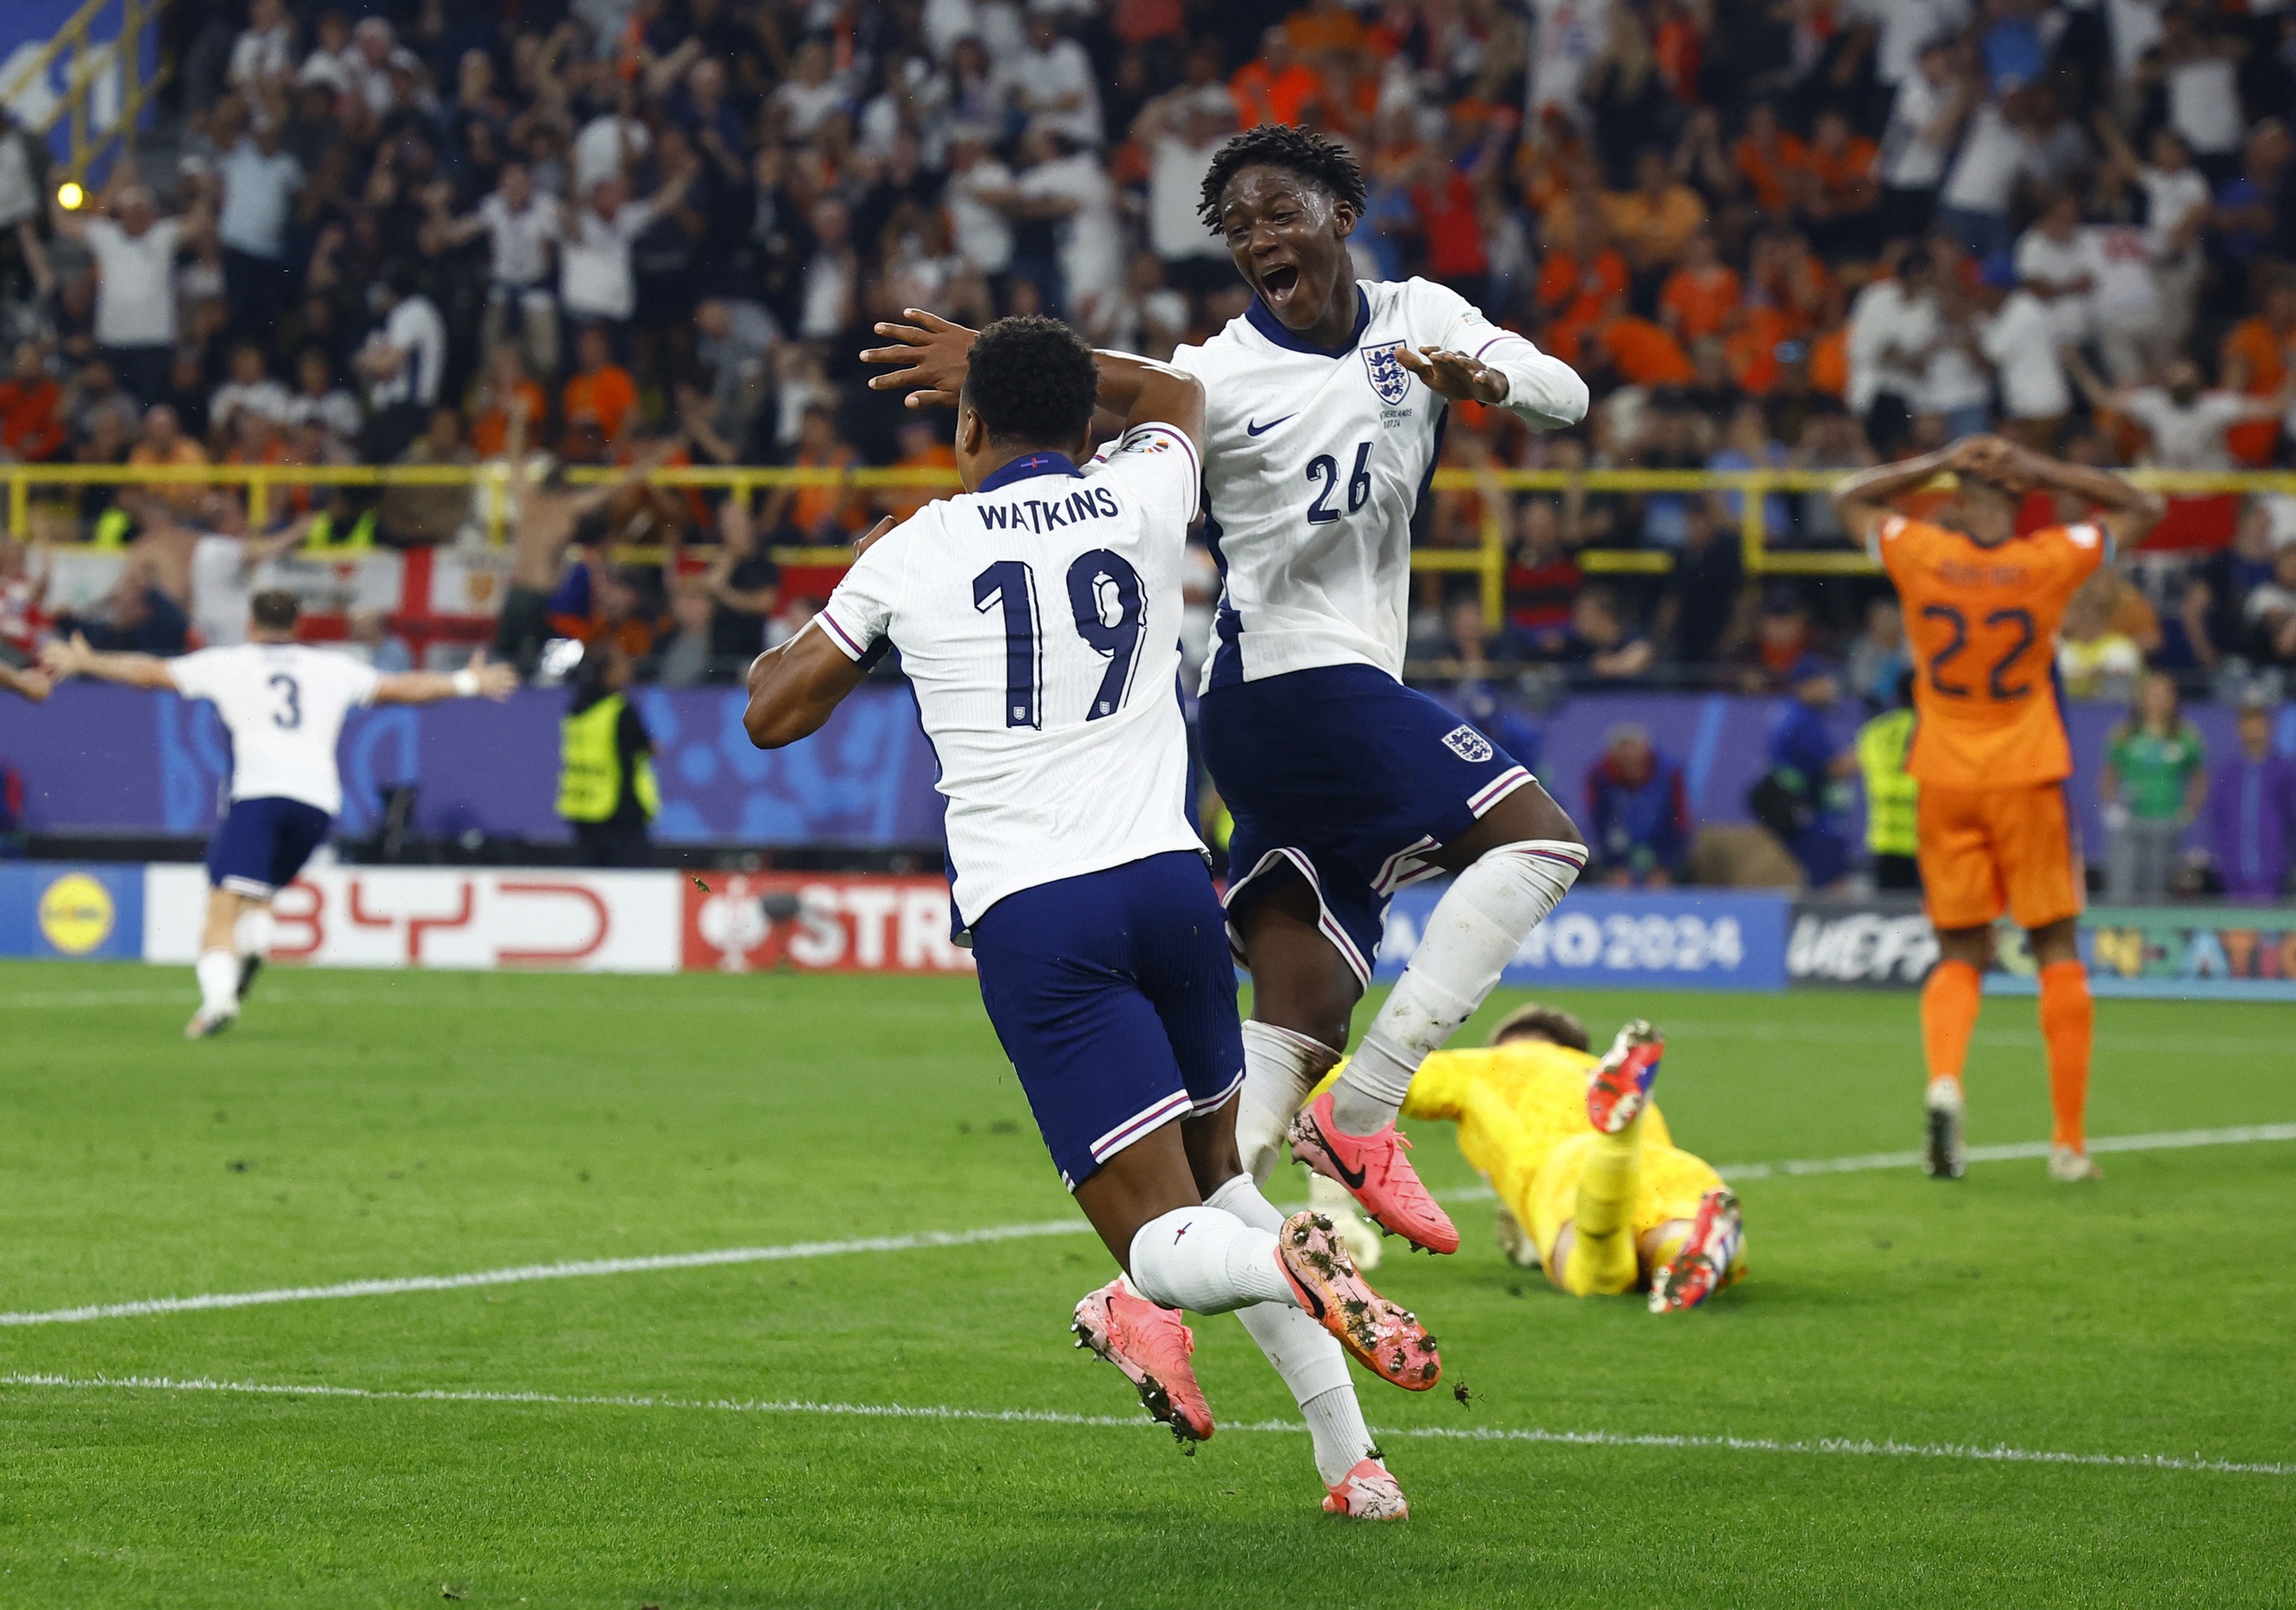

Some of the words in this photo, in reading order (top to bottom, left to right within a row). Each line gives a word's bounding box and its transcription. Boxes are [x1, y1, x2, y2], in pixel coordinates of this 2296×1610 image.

[978, 487, 1118, 535] WATKINS
[1307, 441, 1374, 525] 26
[972, 548, 1148, 731] 19
[1923, 605, 2033, 700] 22
[268, 674, 301, 730] 3
[270, 878, 610, 966] BYD
[788, 883, 978, 970] STR
